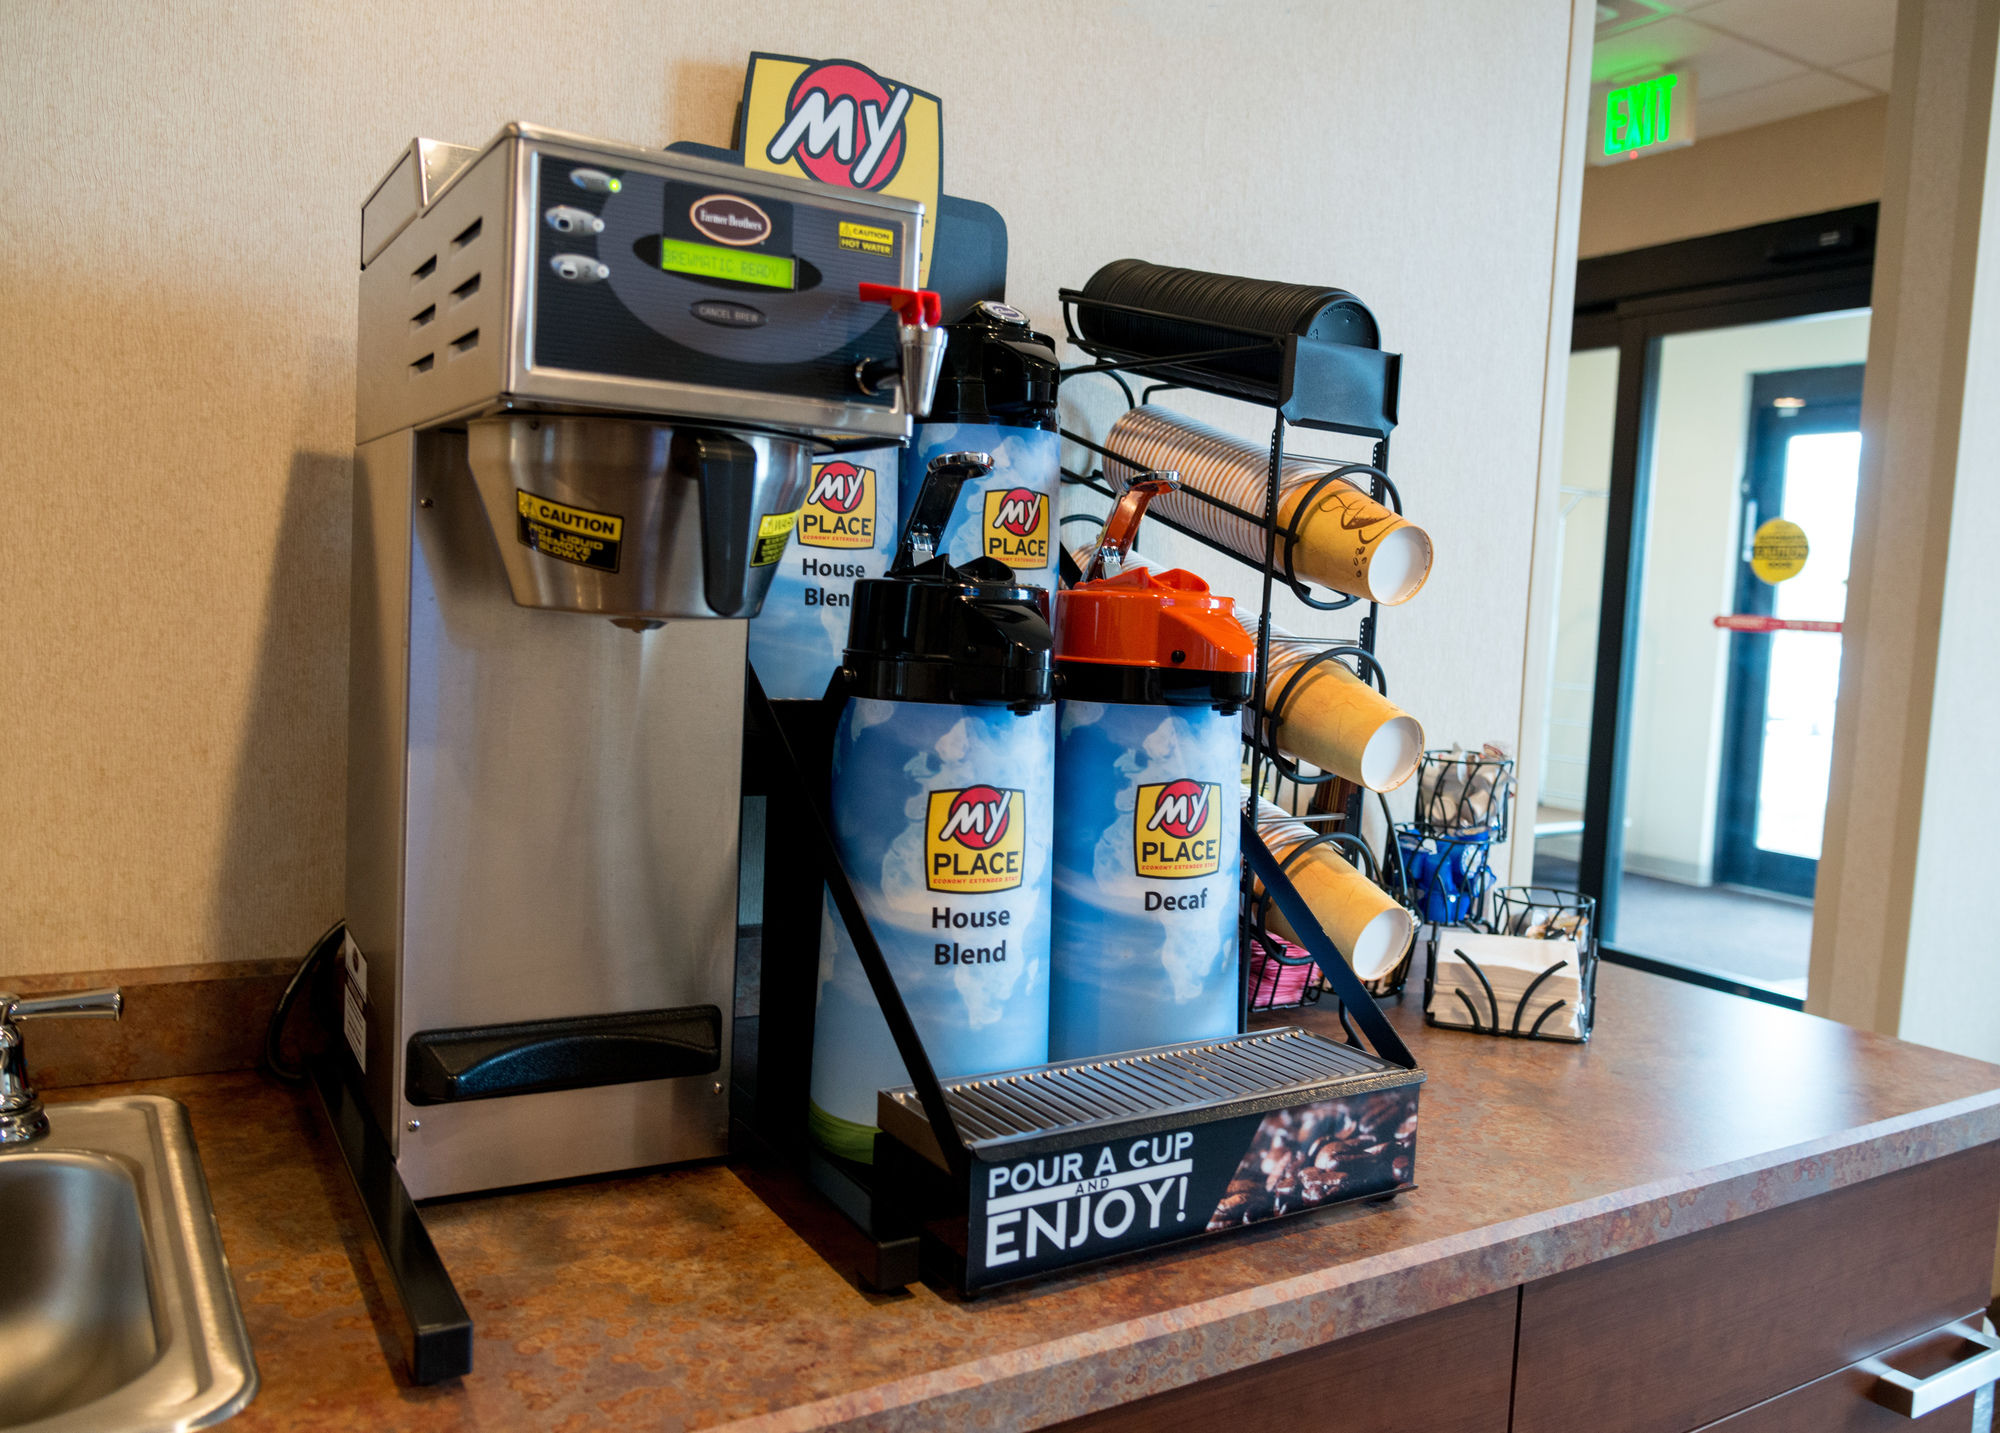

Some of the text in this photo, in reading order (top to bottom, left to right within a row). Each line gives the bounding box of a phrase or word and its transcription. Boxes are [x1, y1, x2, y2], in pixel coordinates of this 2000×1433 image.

[1604, 73, 1678, 156] EXIT
[700, 208, 763, 232] Farmer Brothers
[852, 227, 890, 240] CAUTION
[840, 238, 891, 255] HOT WATER
[740, 262, 780, 280] READY
[699, 306, 760, 323] CANCEL BREW
[539, 505, 615, 535] CAUTION
[803, 514, 872, 537] PLACE
[528, 521, 604, 551] HOT LIQUID
[539, 534, 592, 557] REMOVE
[989, 537, 1046, 557] PLACE
[539, 541, 589, 562] SLOWLY
[802, 558, 865, 578] House
[804, 588, 850, 607] Blen
[1142, 839, 1216, 863] PLACE
[934, 852, 1019, 876] PLACE
[933, 877, 967, 885] ECONOMY
[969, 876, 1002, 884] EXTENDED
[1144, 887, 1208, 912] Decaf
[932, 907, 1010, 929] House
[934, 939, 1006, 966] Blend
[988, 1131, 1194, 1199] POUR A CUP
[1075, 1177, 1110, 1196] AND
[986, 1175, 1189, 1268] ENJOY!
